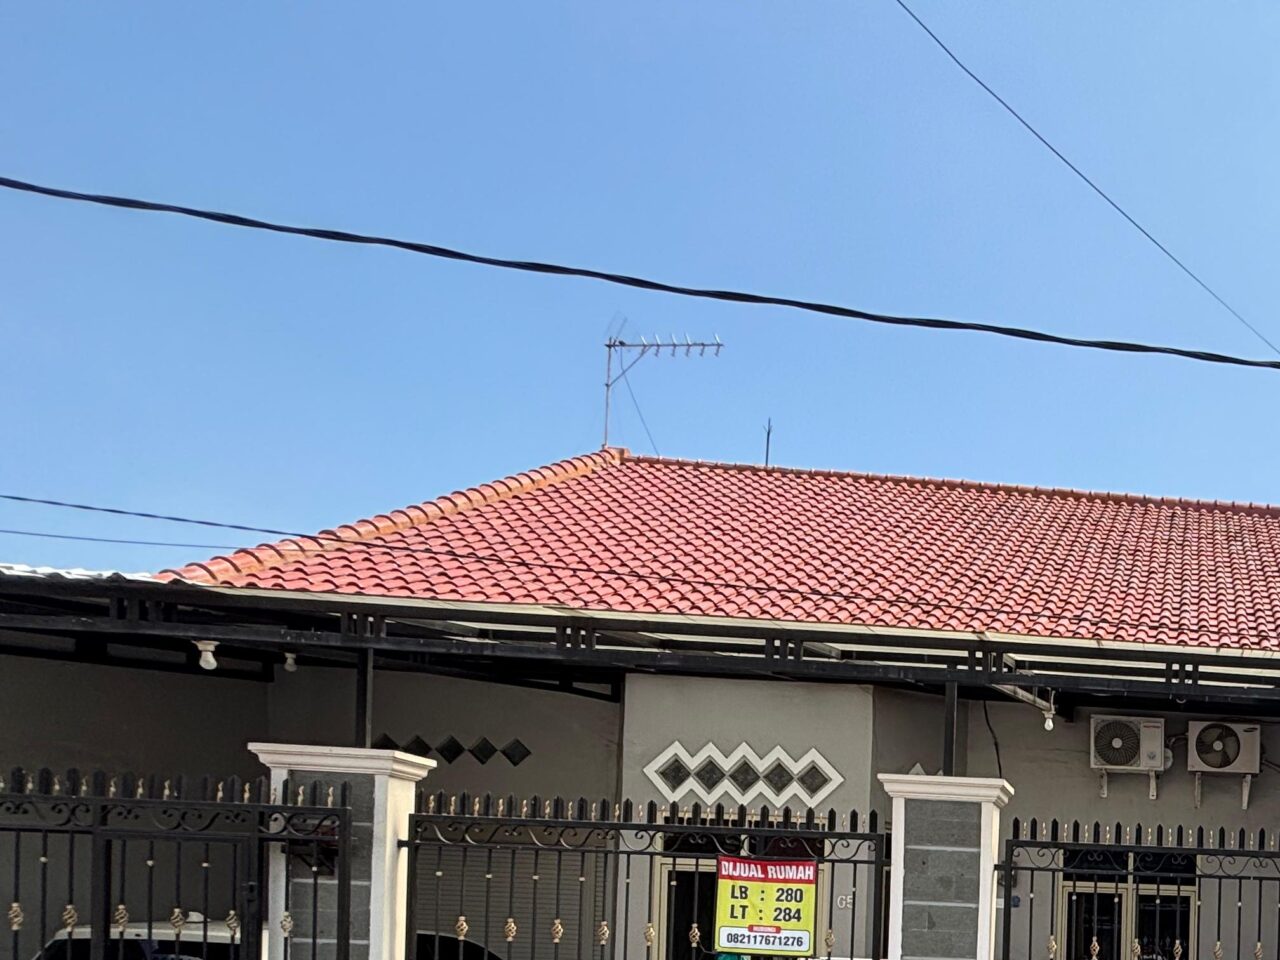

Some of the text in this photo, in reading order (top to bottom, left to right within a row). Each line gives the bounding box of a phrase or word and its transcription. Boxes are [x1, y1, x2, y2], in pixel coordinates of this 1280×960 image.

[721, 861, 814, 880] DIJUAL RUMAH
[731, 884, 749, 900] LB
[775, 887, 804, 903] 280
[730, 904, 749, 919] LT
[773, 907, 802, 922] 284
[726, 933, 804, 947] 082117671276
